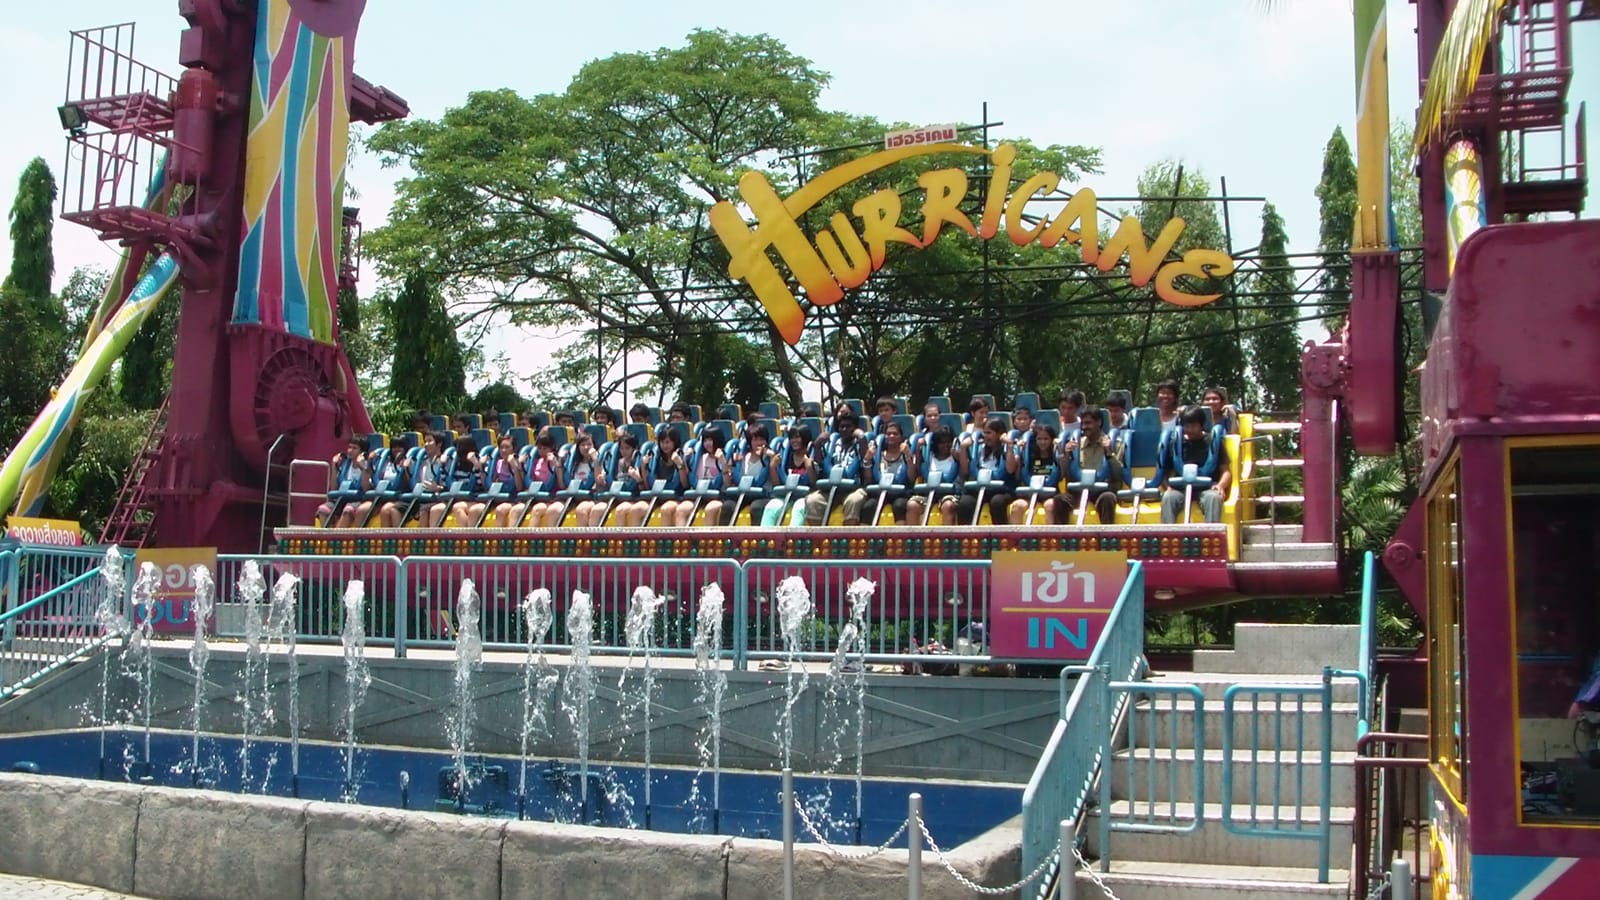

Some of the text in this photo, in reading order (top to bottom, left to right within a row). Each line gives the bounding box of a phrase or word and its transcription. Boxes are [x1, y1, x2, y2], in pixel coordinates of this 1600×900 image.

[709, 143, 1235, 346] HURRICANE
[12, 521, 76, 546] จดวางสิ่งของ
[1021, 560, 1096, 603] เข้า
[137, 599, 207, 625] OU
[1028, 617, 1088, 649] IN
